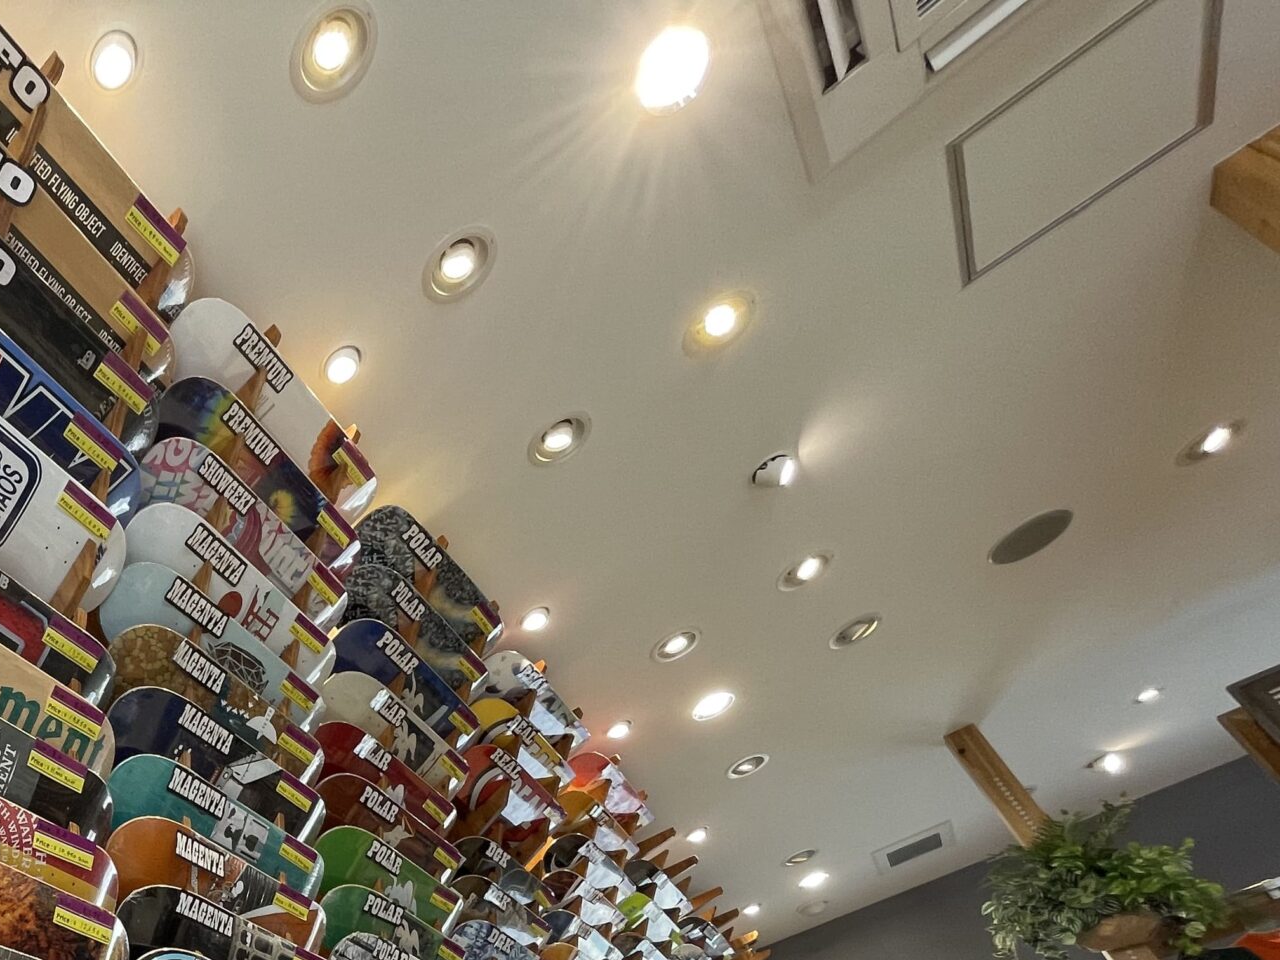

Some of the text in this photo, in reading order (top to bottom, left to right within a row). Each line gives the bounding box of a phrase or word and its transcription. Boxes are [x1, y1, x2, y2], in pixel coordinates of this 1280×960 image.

[47, 173, 79, 209] FLYING
[74, 203, 107, 239] OBJECT
[236, 327, 292, 391] PREMIUM
[223, 403, 280, 466] PREMIUM
[199, 455, 256, 516] SHOWGEKI
[187, 525, 248, 586] MAGENTA
[402, 524, 443, 570] POLAR
[165, 579, 229, 638] MAGENTA
[391, 580, 427, 622] POLAR
[173, 639, 227, 695] MAGENTA
[376, 630, 420, 674] POLAR
[177, 703, 234, 756] MAGENTA
[370, 689, 408, 727] LAR
[353, 733, 393, 772] LAR
[490, 748, 522, 781] REAL
[169, 768, 226, 818] MAGENTA
[360, 785, 400, 824] POLAR
[175, 831, 225, 877] MAGENTA
[366, 840, 403, 875] POLAR
[485, 843, 511, 868] DGK
[175, 892, 234, 937] MAGENTA
[363, 893, 406, 926] POLAR
[489, 927, 516, 954] DGK
